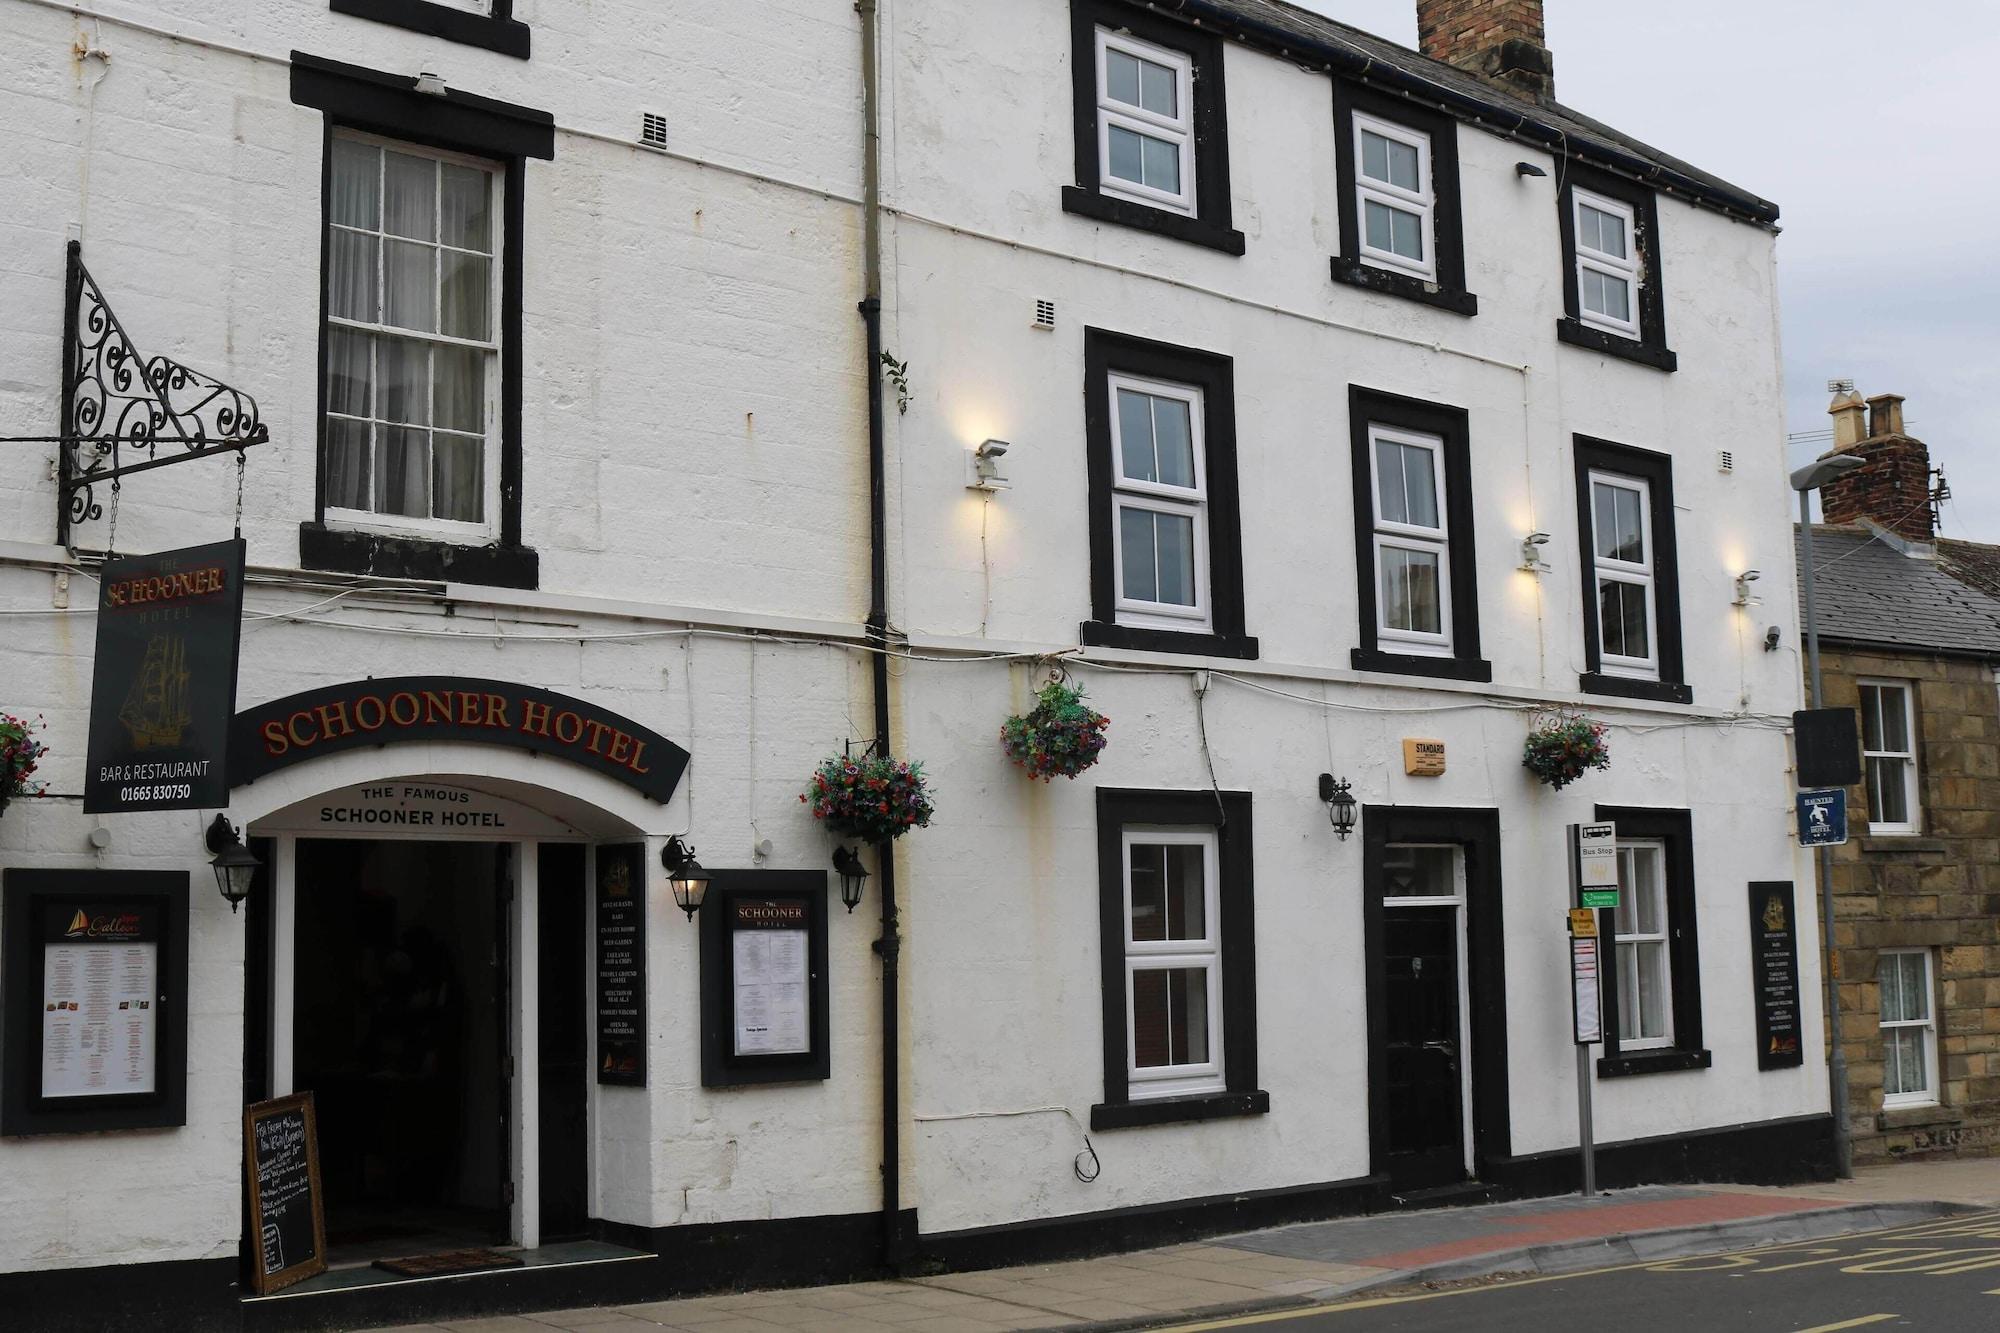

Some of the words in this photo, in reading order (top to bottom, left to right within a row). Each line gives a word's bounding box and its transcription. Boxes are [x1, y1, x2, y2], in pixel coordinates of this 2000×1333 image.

[104, 566, 223, 608] SCHOONER
[139, 608, 192, 625] HOTEL
[261, 690, 511, 758] SCHOONER
[519, 697, 650, 775] HOTEL
[100, 765, 122, 782] BAR
[124, 765, 132, 781] &
[133, 760, 210, 780] RESTAURANT
[121, 785, 151, 802] 01665
[152, 783, 191, 800] 830750
[361, 787, 394, 801] THE
[403, 787, 470, 804] FAMOUS
[320, 807, 434, 826] SCHOONER
[440, 810, 505, 828] HOTEL
[1583, 848, 1596, 856] Bus
[1597, 847, 1614, 855] Stop
[738, 907, 803, 919] SCHOONER
